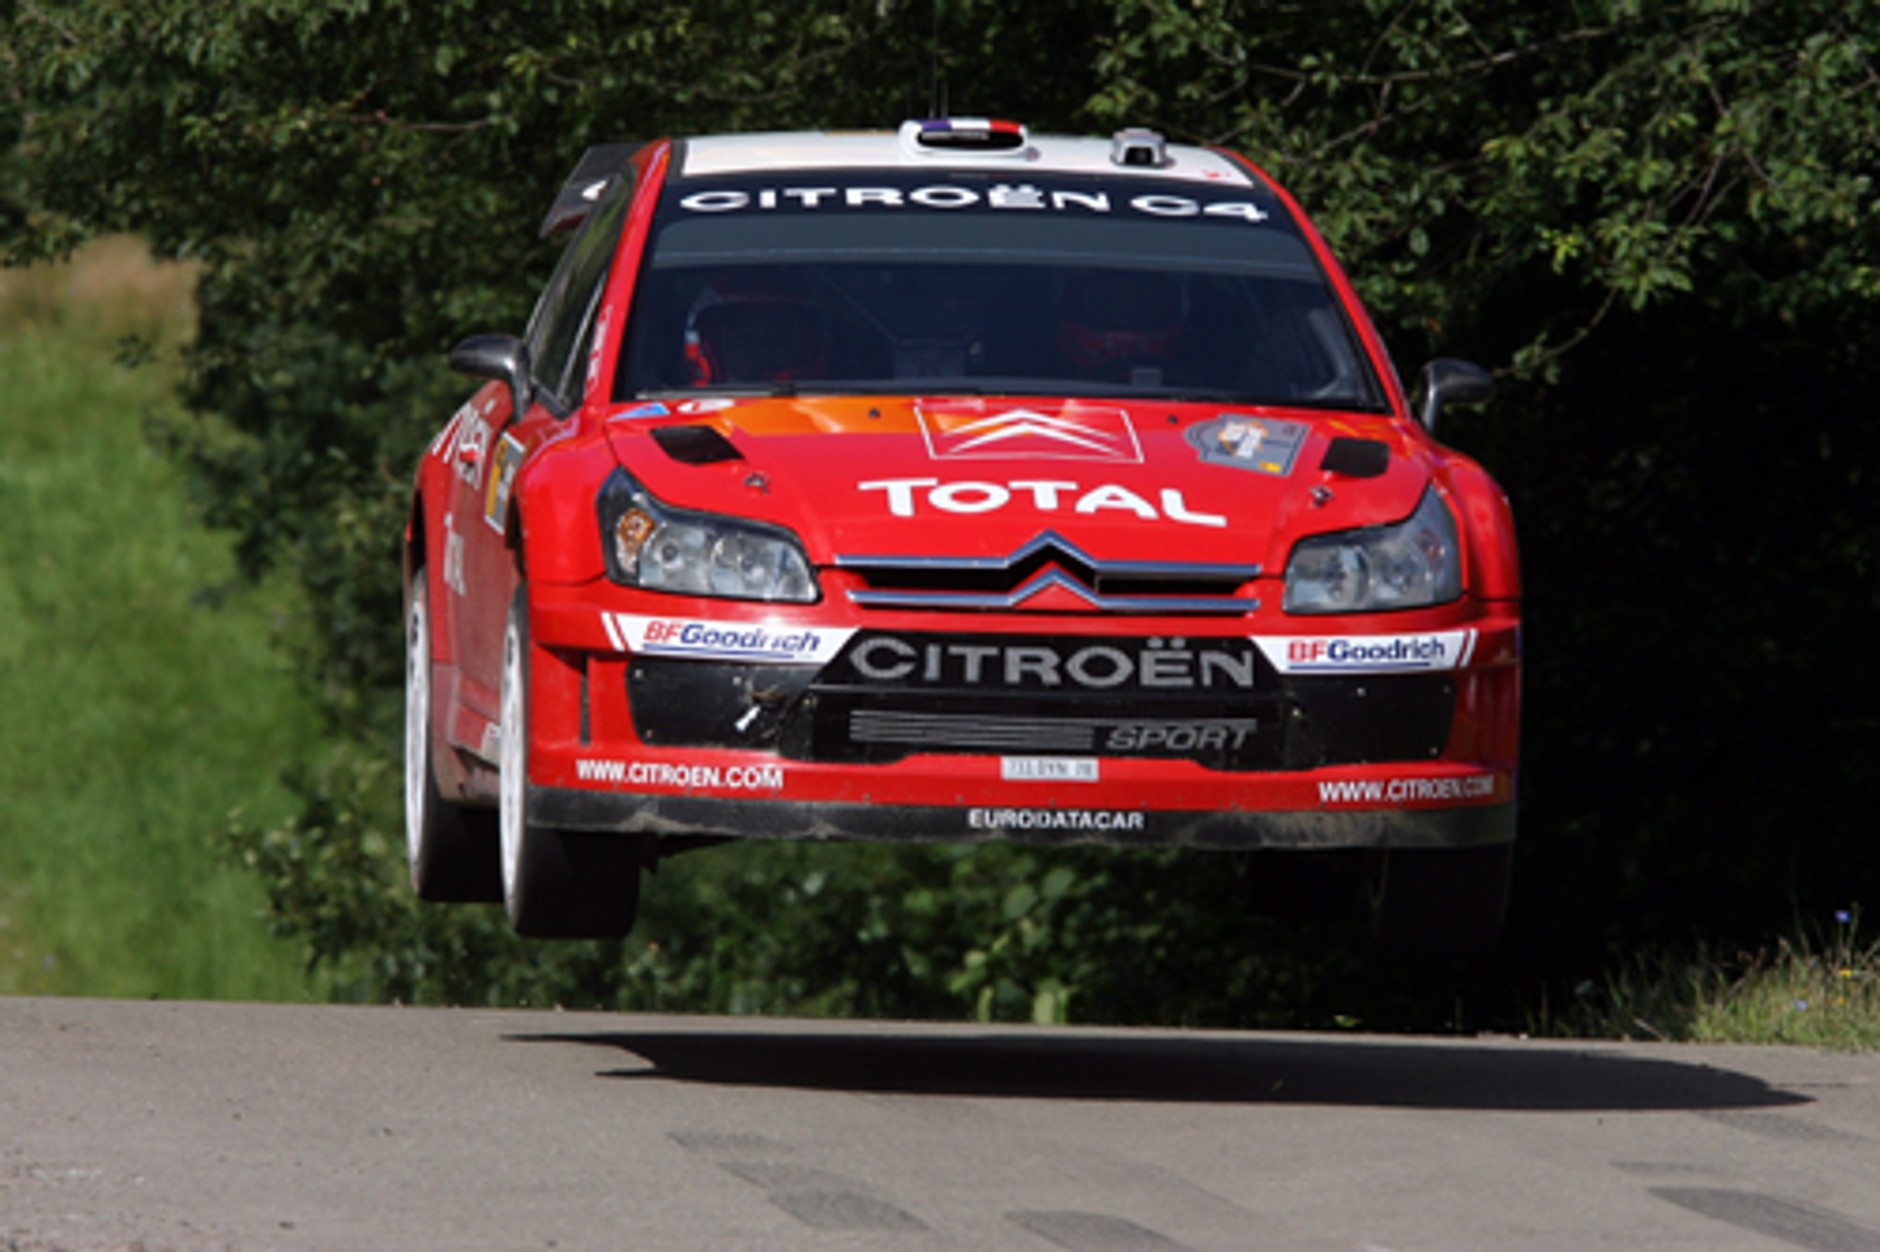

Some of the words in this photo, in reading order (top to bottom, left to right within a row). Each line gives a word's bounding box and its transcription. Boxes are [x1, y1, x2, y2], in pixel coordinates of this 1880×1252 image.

[1131, 195, 1268, 222] C4
[857, 477, 1227, 526] TOTAL
[849, 637, 1254, 688] CITROËN
[1288, 638, 1445, 662] BFGoodrich
[1106, 719, 1257, 750] SPORT
[576, 759, 783, 789] WWW.CITROEN.COM
[968, 808, 1145, 830] EURODATACAR
